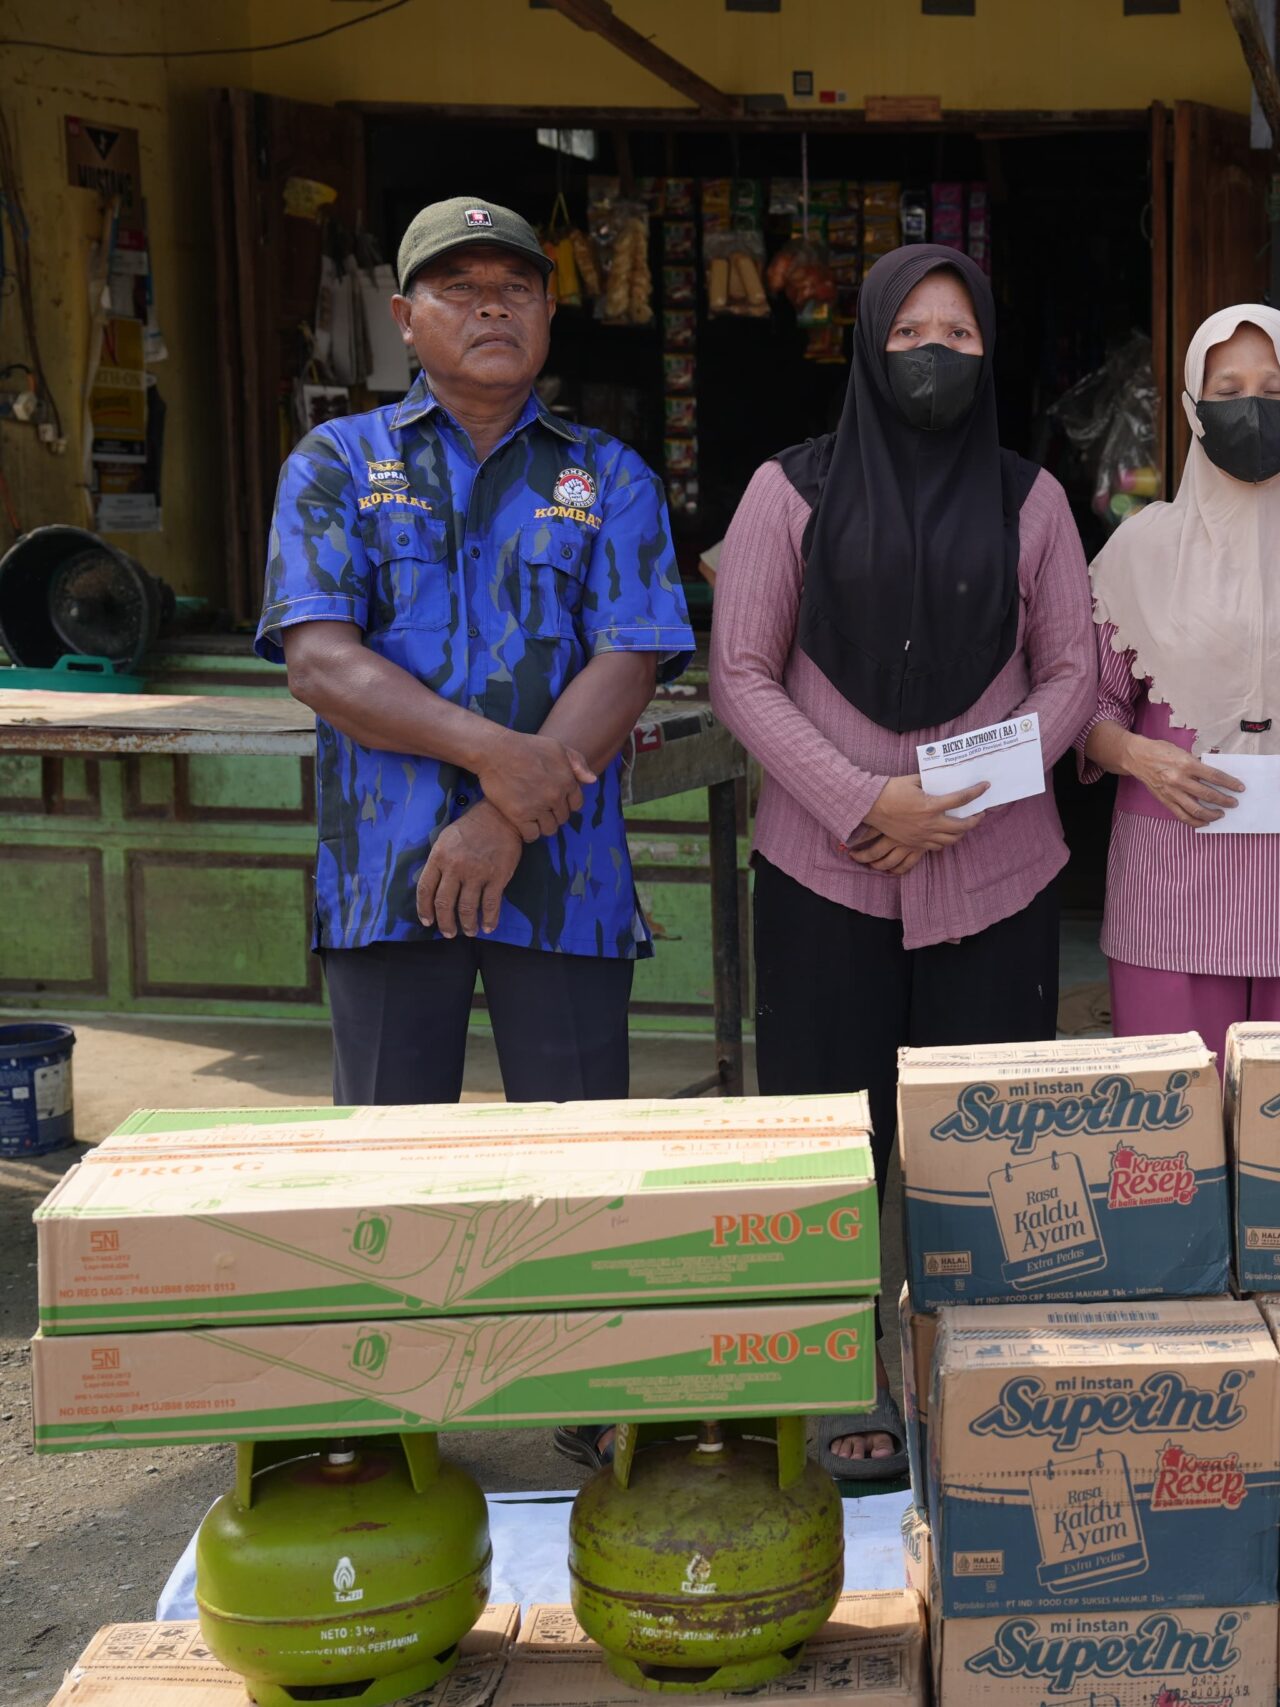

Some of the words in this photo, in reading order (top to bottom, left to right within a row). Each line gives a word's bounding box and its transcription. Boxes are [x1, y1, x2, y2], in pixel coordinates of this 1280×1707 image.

[358, 493, 433, 511] KOPRAL
[534, 506, 602, 530] KOMBAT
[942, 738, 964, 754] RICKY
[966, 729, 997, 749] ANTHONY
[1003, 727, 1013, 737] RA
[1009, 1083, 1029, 1097] mi
[1033, 1080, 1084, 1095] instan
[931, 1071, 1193, 1154] SuperMi
[1131, 1152, 1185, 1174] Kreasi
[1027, 1187, 1059, 1205] Rasa
[1111, 1170, 1194, 1202] Resep
[711, 1207, 862, 1247] PRO-G
[1014, 1201, 1079, 1234] Kaldu
[90, 1230, 118, 1252] SNI
[1022, 1221, 1086, 1253] Ayam
[940, 1257, 967, 1265] HALAL
[1027, 1254, 1054, 1274] Extra
[1057, 1248, 1084, 1265] Pedas
[59, 1288, 75, 1299] NO
[79, 1287, 99, 1298] REG
[1046, 1291, 1072, 1300] SUKSES
[1075, 1289, 1109, 1299] MAKMUR
[1112, 1288, 1126, 1297] Tbk
[91, 1348, 119, 1369] SNI
[708, 1328, 860, 1367] PRO-G
[1055, 1377, 1077, 1390] mi
[1081, 1377, 1133, 1390] instan
[59, 1405, 75, 1416] NO
[79, 1405, 99, 1415] REG
[969, 1370, 1247, 1452] SuperMi
[1179, 1453, 1240, 1473] Kreasi
[1156, 1468, 1243, 1495] Resep
[1067, 1485, 1102, 1506] Rasa
[1054, 1499, 1122, 1535] Kaldu
[1059, 1521, 1128, 1555] Ayam
[972, 1557, 1000, 1565] HALAL
[1063, 1558, 1092, 1575] Extra
[1096, 1551, 1126, 1568] Pedas
[1082, 1597, 1110, 1605] SUKSES
[1112, 1595, 1147, 1604] MAKMUR
[320, 1627, 348, 1641] NETO
[355, 1626, 362, 1638] 3
[1050, 1621, 1072, 1633] mi
[1076, 1619, 1129, 1633] instan
[367, 1633, 419, 1655] PERTAMINA
[965, 1612, 1241, 1694] SuperMi
